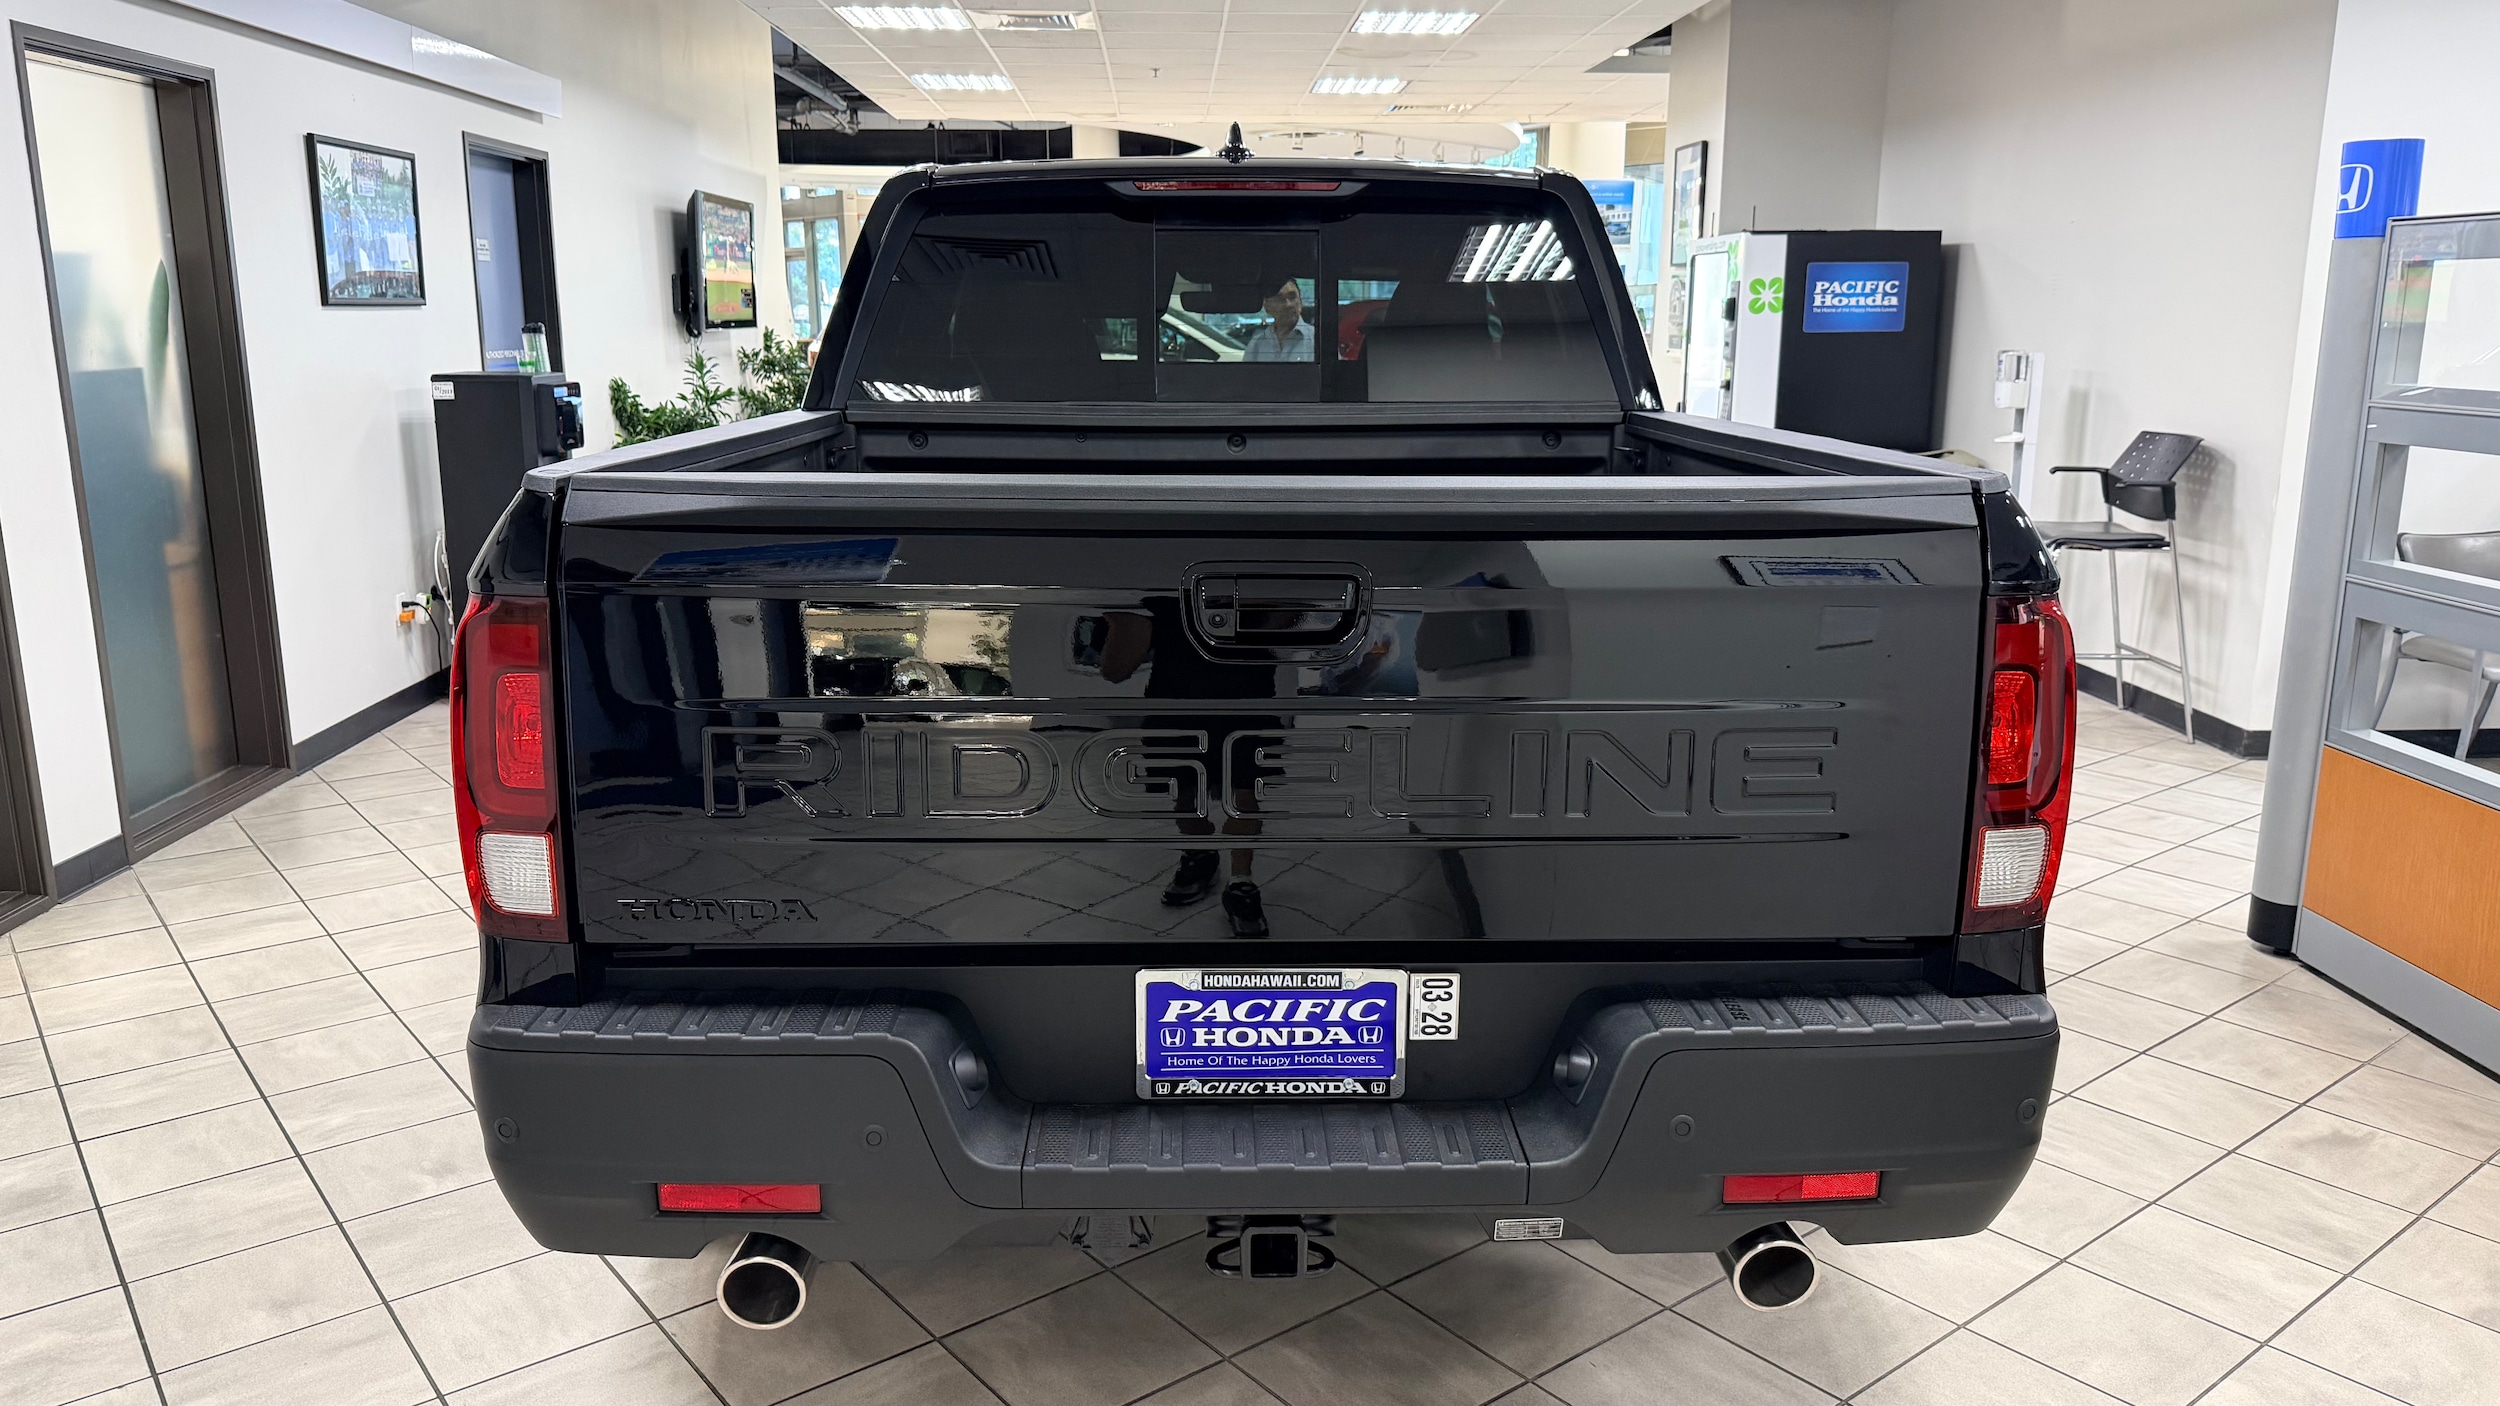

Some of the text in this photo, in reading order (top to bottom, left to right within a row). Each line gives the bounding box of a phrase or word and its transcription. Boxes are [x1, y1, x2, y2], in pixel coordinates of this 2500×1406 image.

[1814, 281, 1899, 294] PACIFIC
[1813, 294, 1898, 306] Honda
[701, 726, 1838, 818] RIDGELINE
[617, 899, 818, 921] HONDA
[1204, 974, 1340, 987] HONDAHAWAII.COM
[1158, 999, 1387, 1022] PACIFIC
[1420, 978, 1454, 1035] 03 28
[1192, 1027, 1356, 1047] HONDA
[1168, 1053, 1377, 1067] Home Of The Happy Honda Lovers
